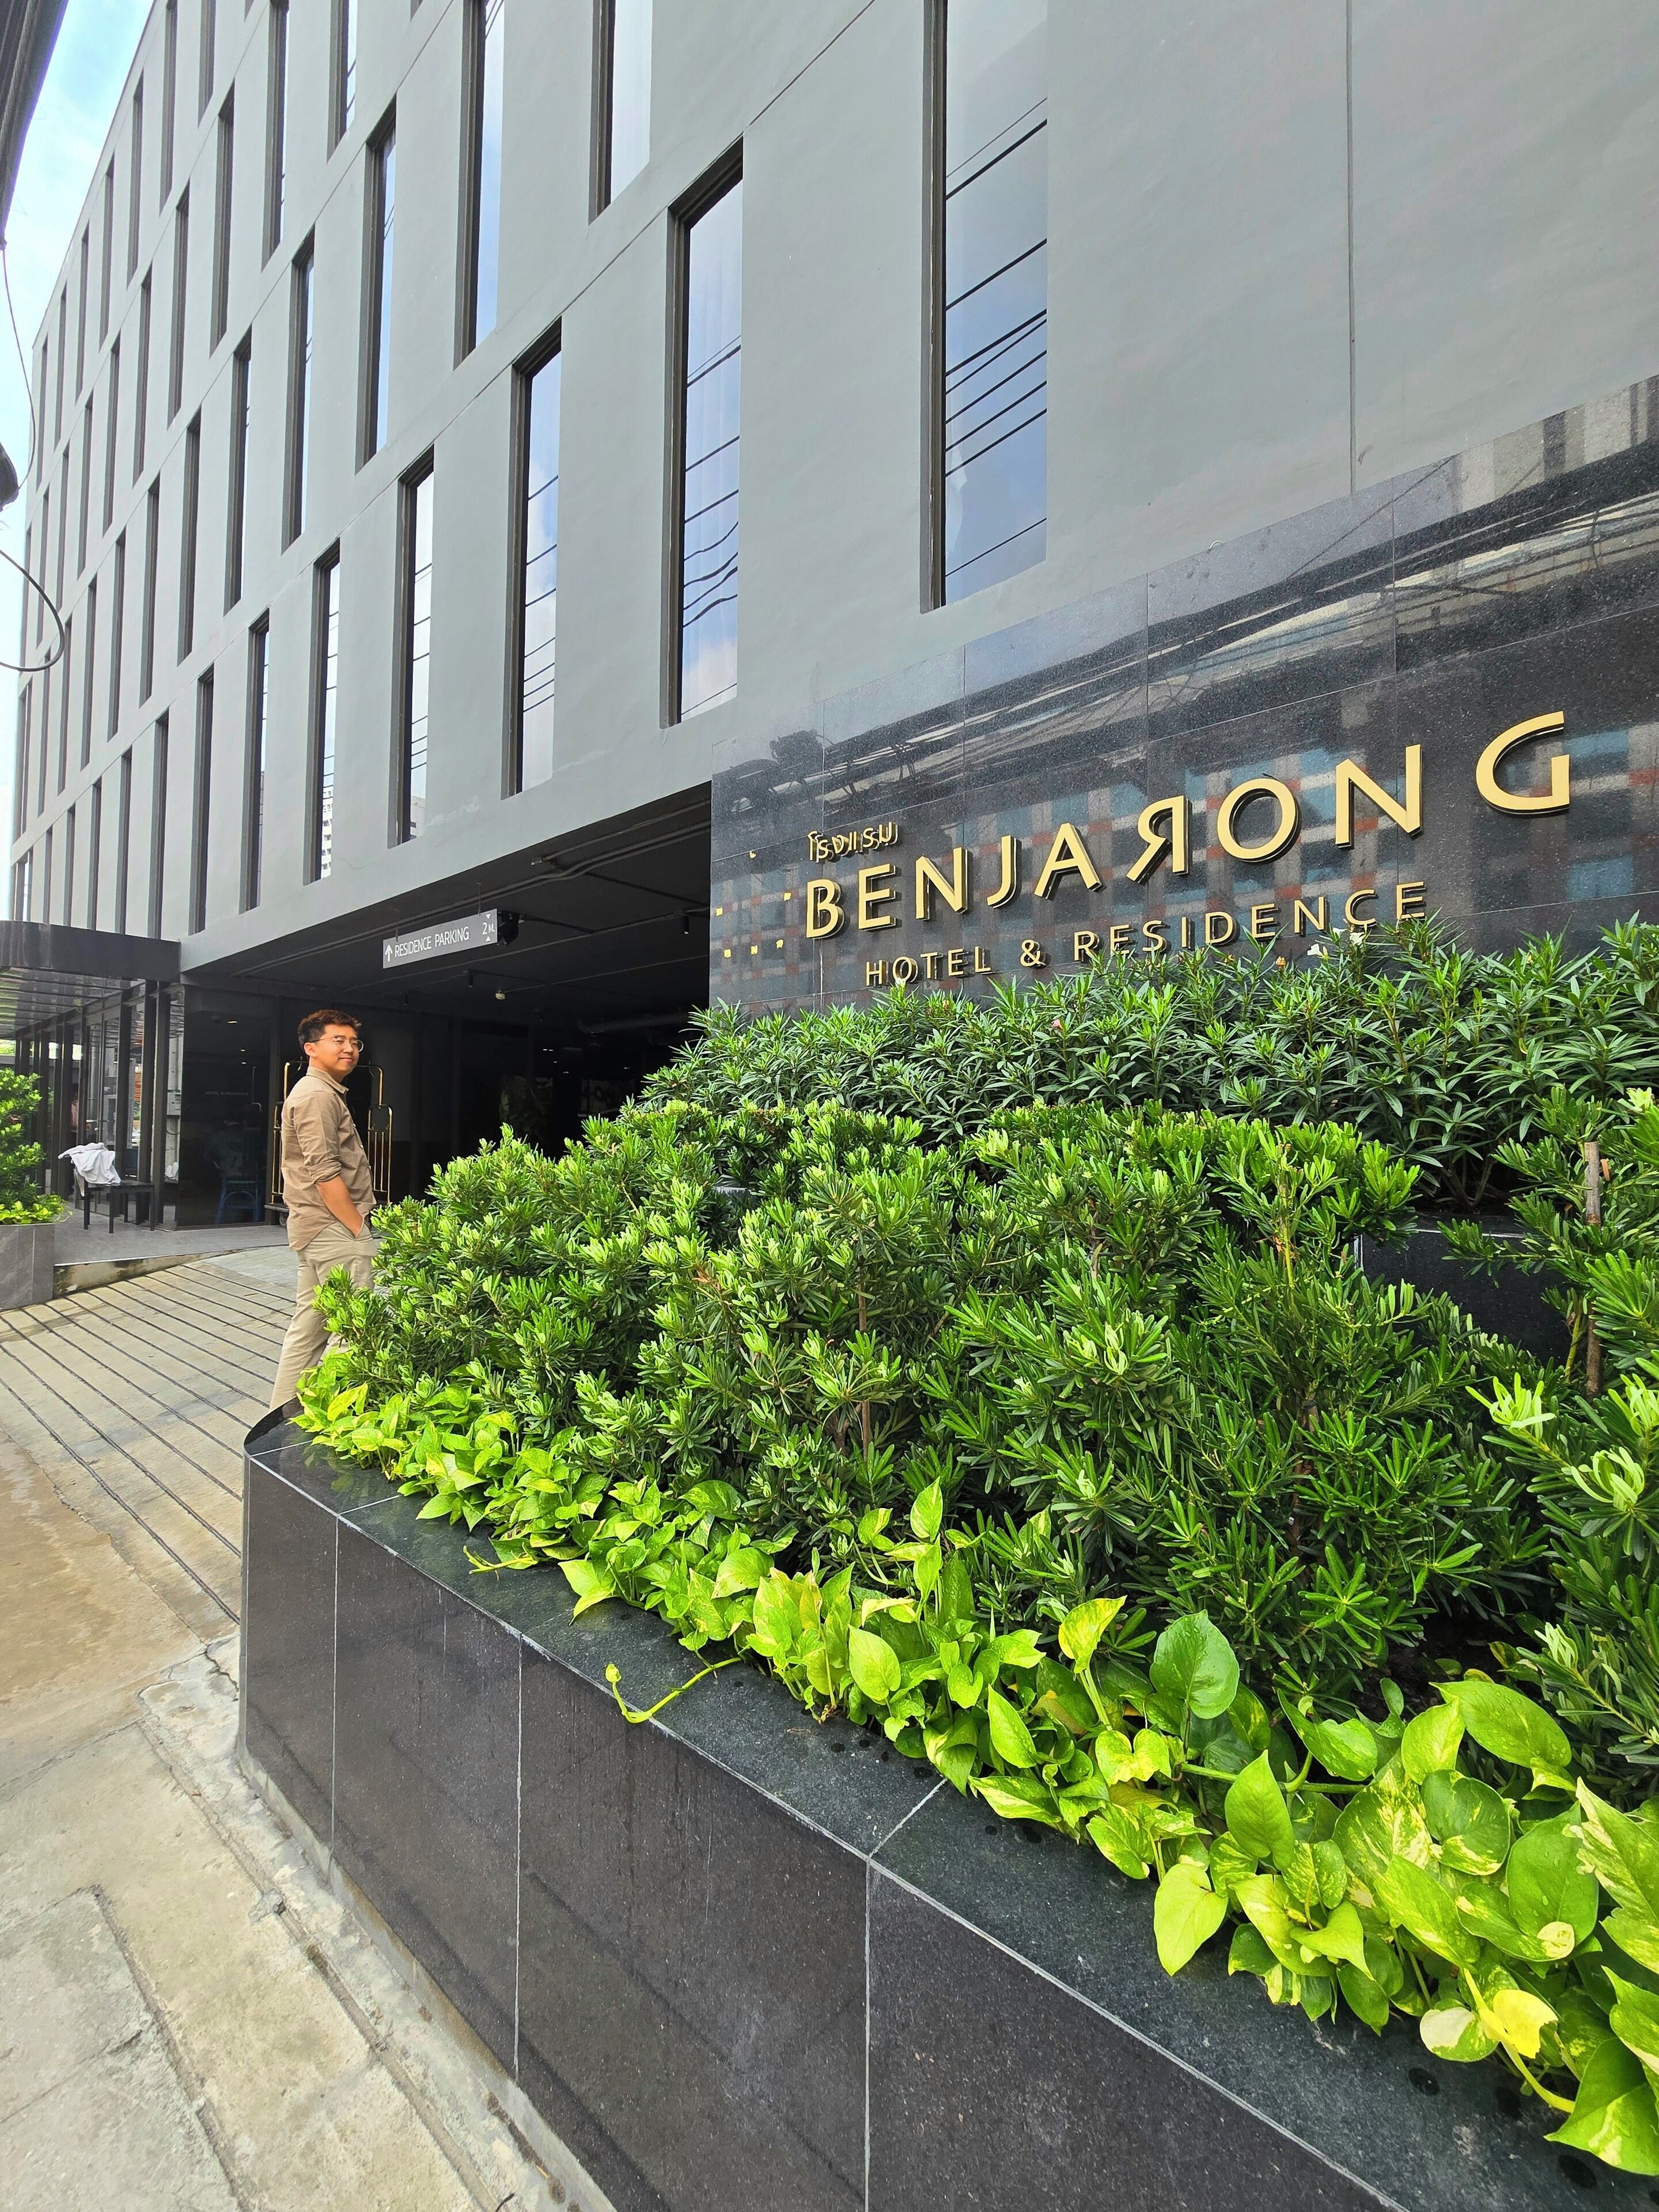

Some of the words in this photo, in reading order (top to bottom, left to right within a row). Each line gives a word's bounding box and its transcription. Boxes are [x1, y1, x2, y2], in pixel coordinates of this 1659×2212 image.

[806, 710, 1570, 939] BENJARONG
[395, 936, 432, 958] RESIDENCE
[435, 926, 469, 948] PARKING
[865, 946, 991, 987] HOTEL
[1020, 939, 1043, 967] &
[1073, 881, 1425, 961] RESIDENCE
